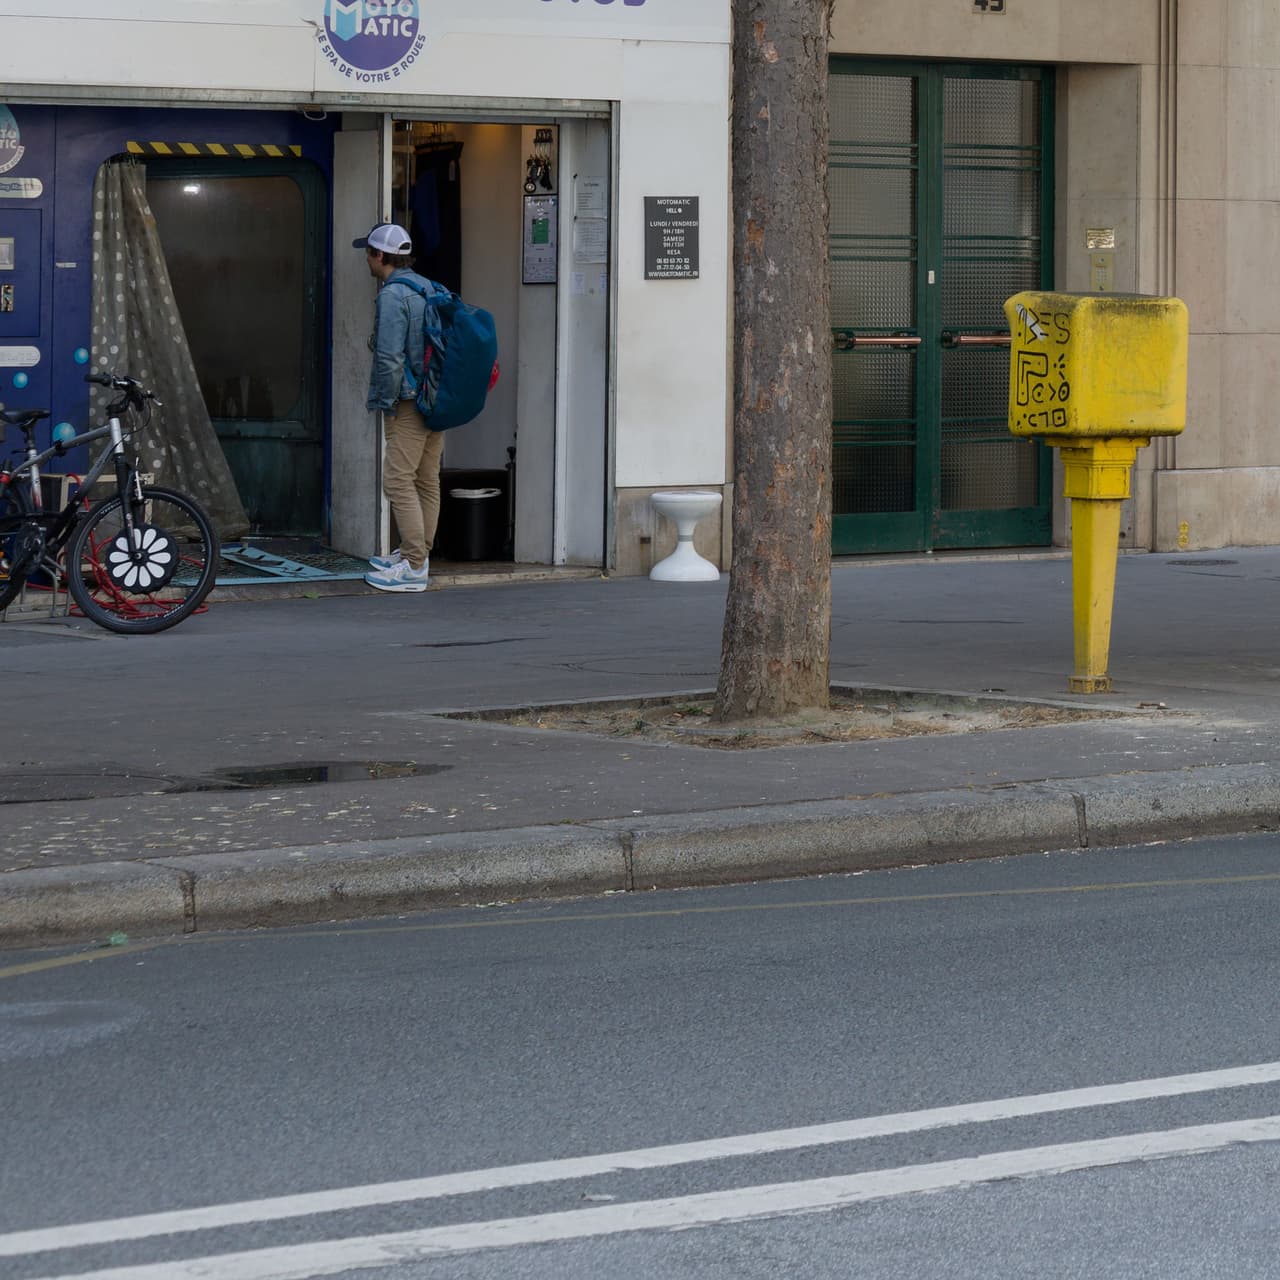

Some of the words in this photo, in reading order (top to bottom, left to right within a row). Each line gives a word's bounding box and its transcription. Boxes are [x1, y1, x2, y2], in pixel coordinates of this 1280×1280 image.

[322, 44, 338, 67] SPA
[338, 64, 353, 78] DE
[355, 71, 391, 83] VOTRE
[393, 66, 401, 76] 2
[400, 33, 426, 70] ROUES
